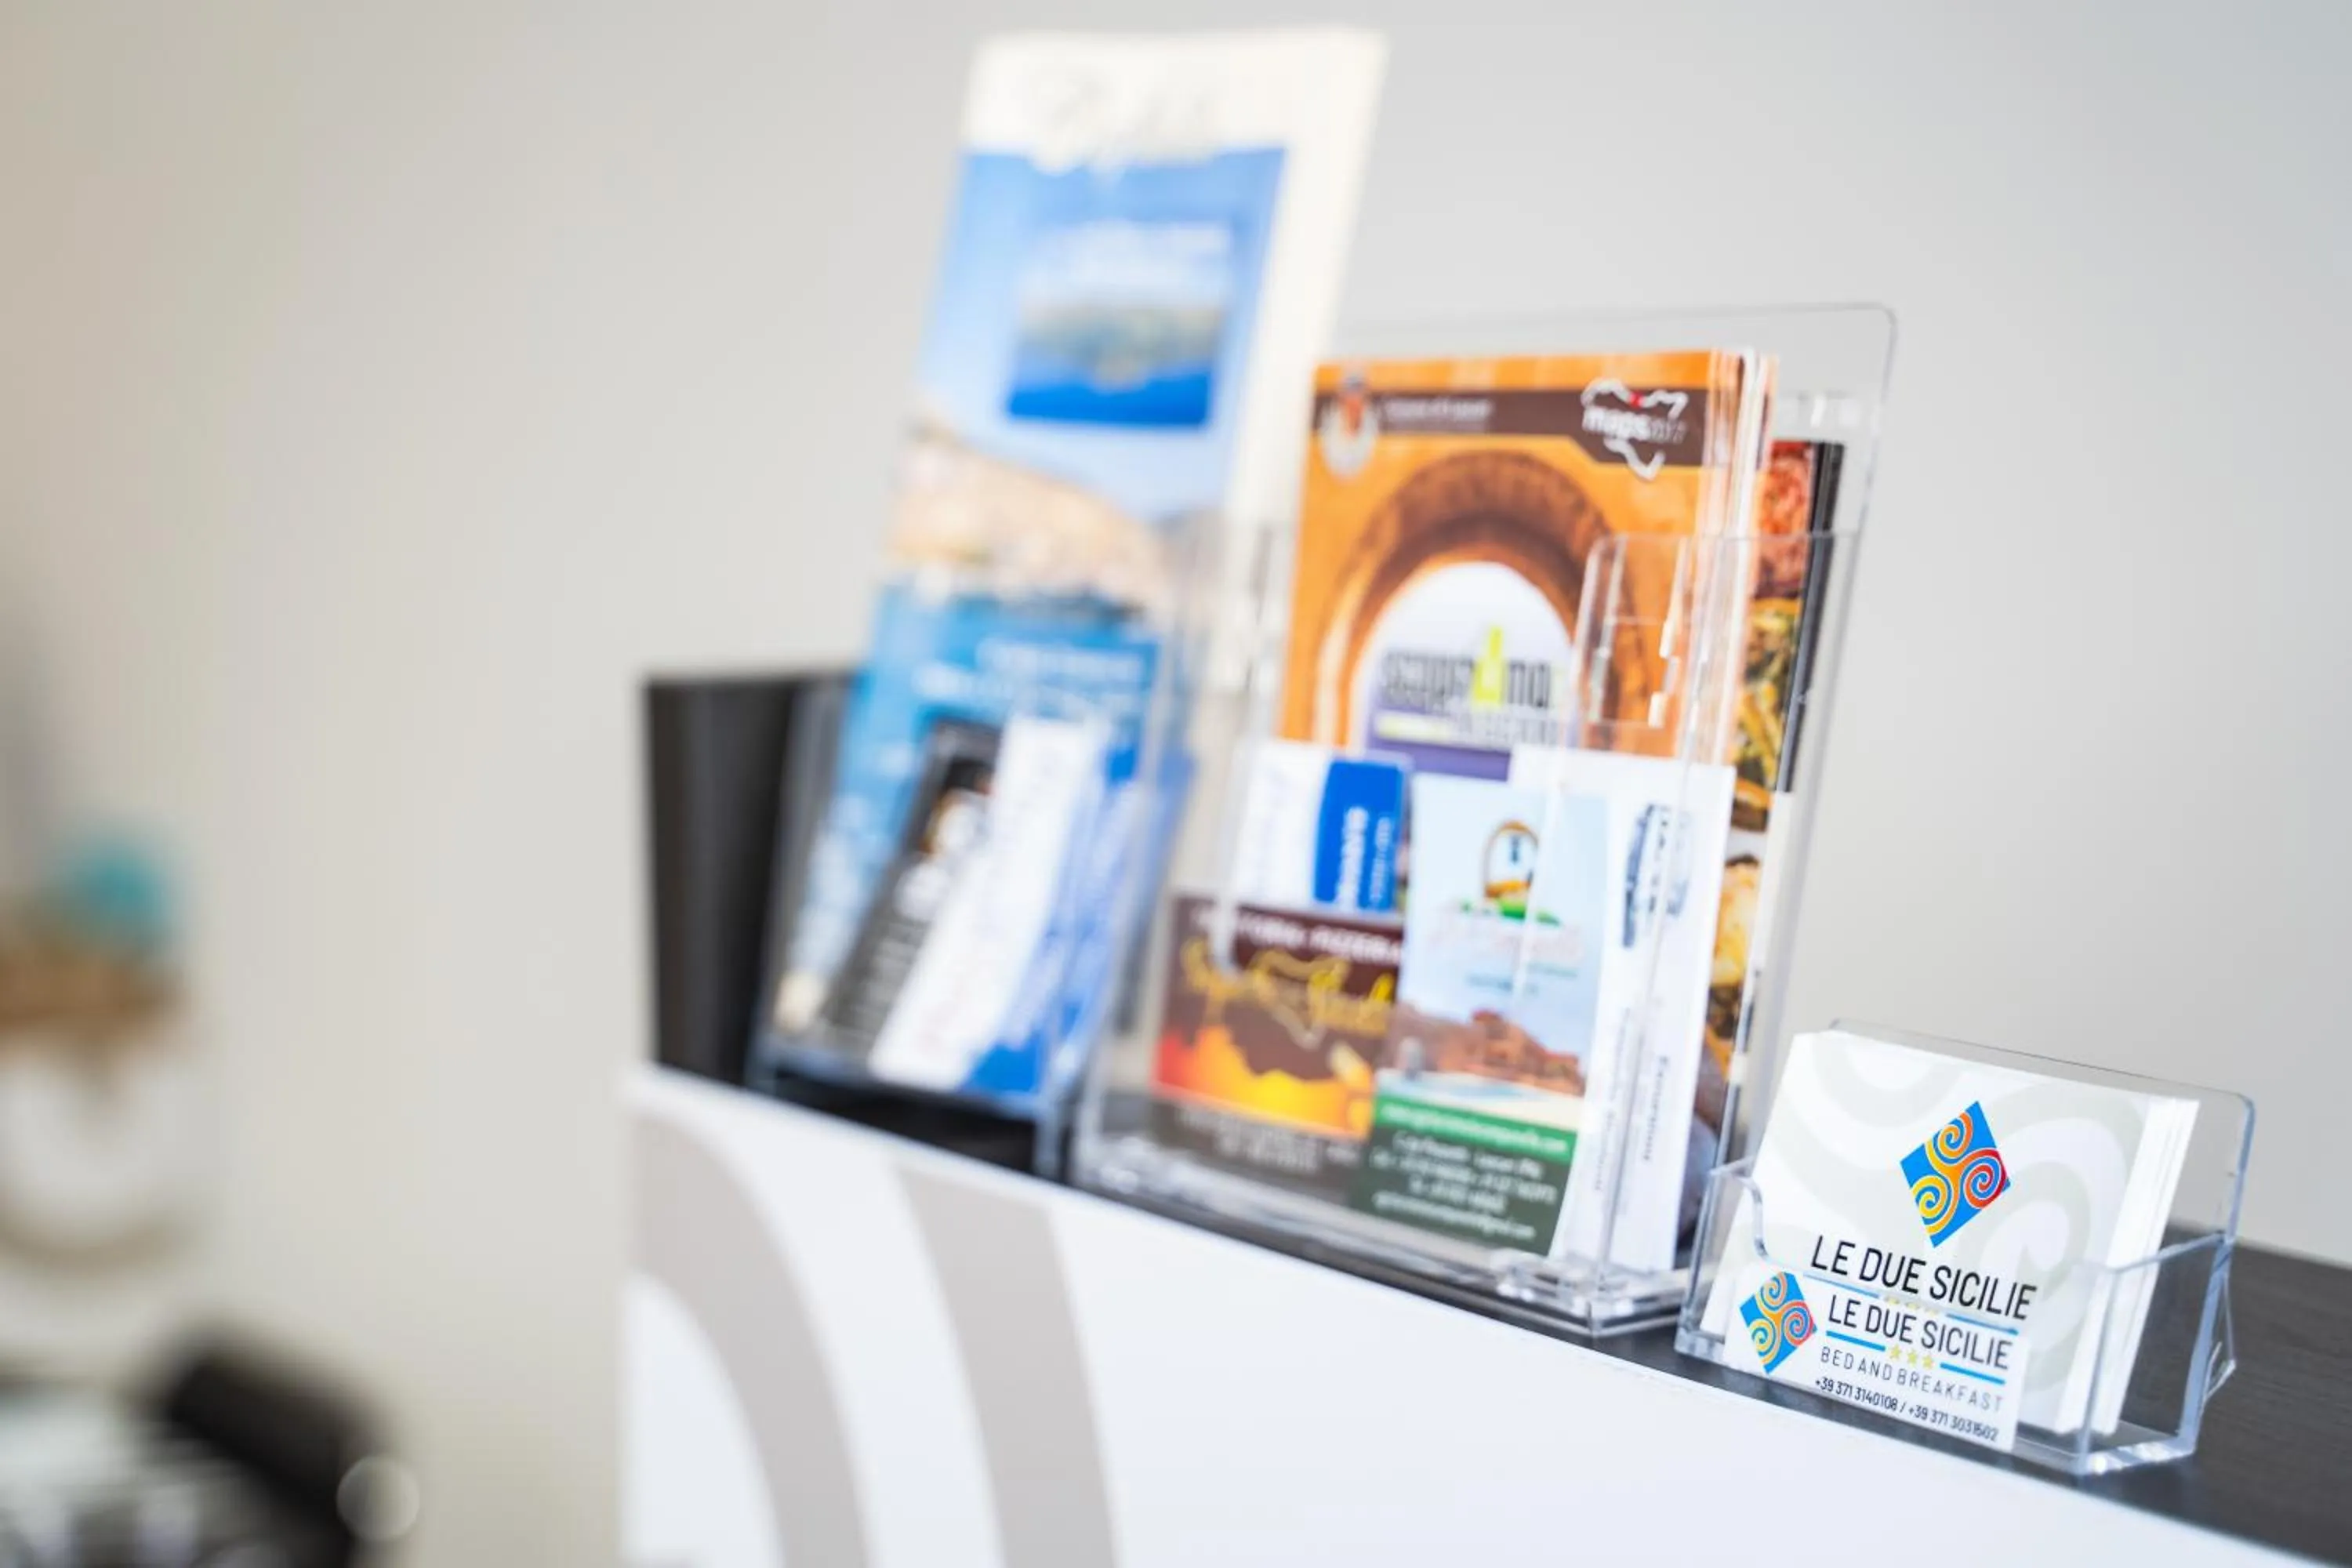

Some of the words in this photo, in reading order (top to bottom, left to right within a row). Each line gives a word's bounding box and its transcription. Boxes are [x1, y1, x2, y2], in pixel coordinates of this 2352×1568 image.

[1810, 1235, 1856, 1276] LE
[1859, 1247, 1926, 1294] DUE
[1929, 1265, 2037, 1320] SICILIE
[1828, 1294, 1860, 1328] LE
[1865, 1305, 1917, 1344] DUE
[1921, 1319, 2013, 1370] SICILIE
[1815, 1376, 1835, 1392] +39
[1835, 1380, 1853, 1399] 371
[1854, 1386, 1898, 1411] 3140108
[1908, 1404, 1928, 1421] +39
[1929, 1409, 1949, 1426] 371
[1820, 1345, 1855, 1370] BED
[1857, 1357, 1893, 1381] AND
[1896, 1367, 2004, 1412] BREAKFAST
